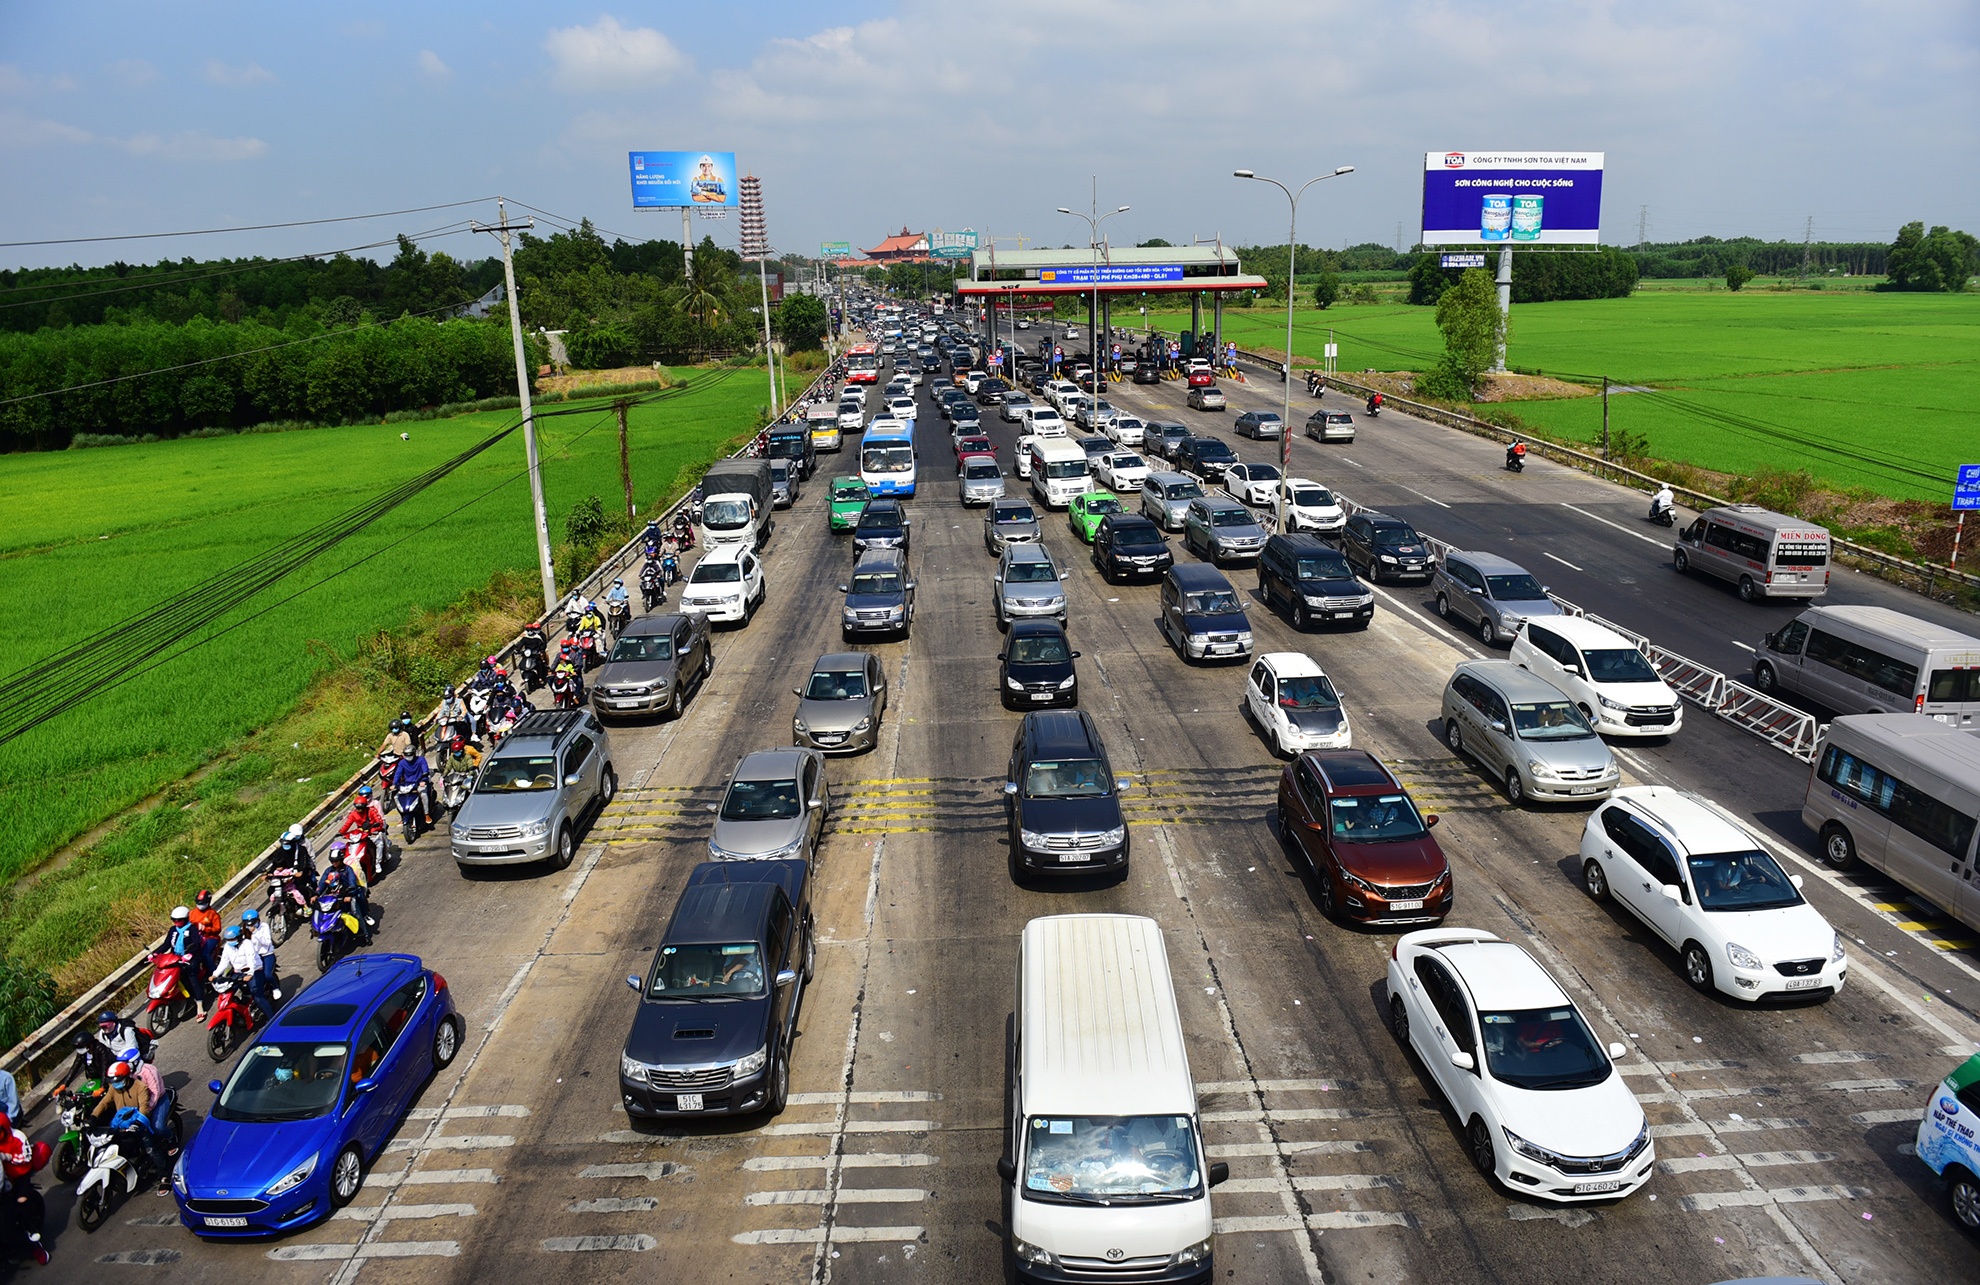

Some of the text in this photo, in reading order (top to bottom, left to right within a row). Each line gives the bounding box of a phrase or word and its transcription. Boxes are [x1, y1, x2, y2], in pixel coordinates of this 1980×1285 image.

[1554, 156, 1569, 165] VIỆT
[1455, 178, 1573, 188] SƠN CÔNG NGHỆ CHO CUỘC SỐNG
[1957, 1123, 1974, 1138] THAO
